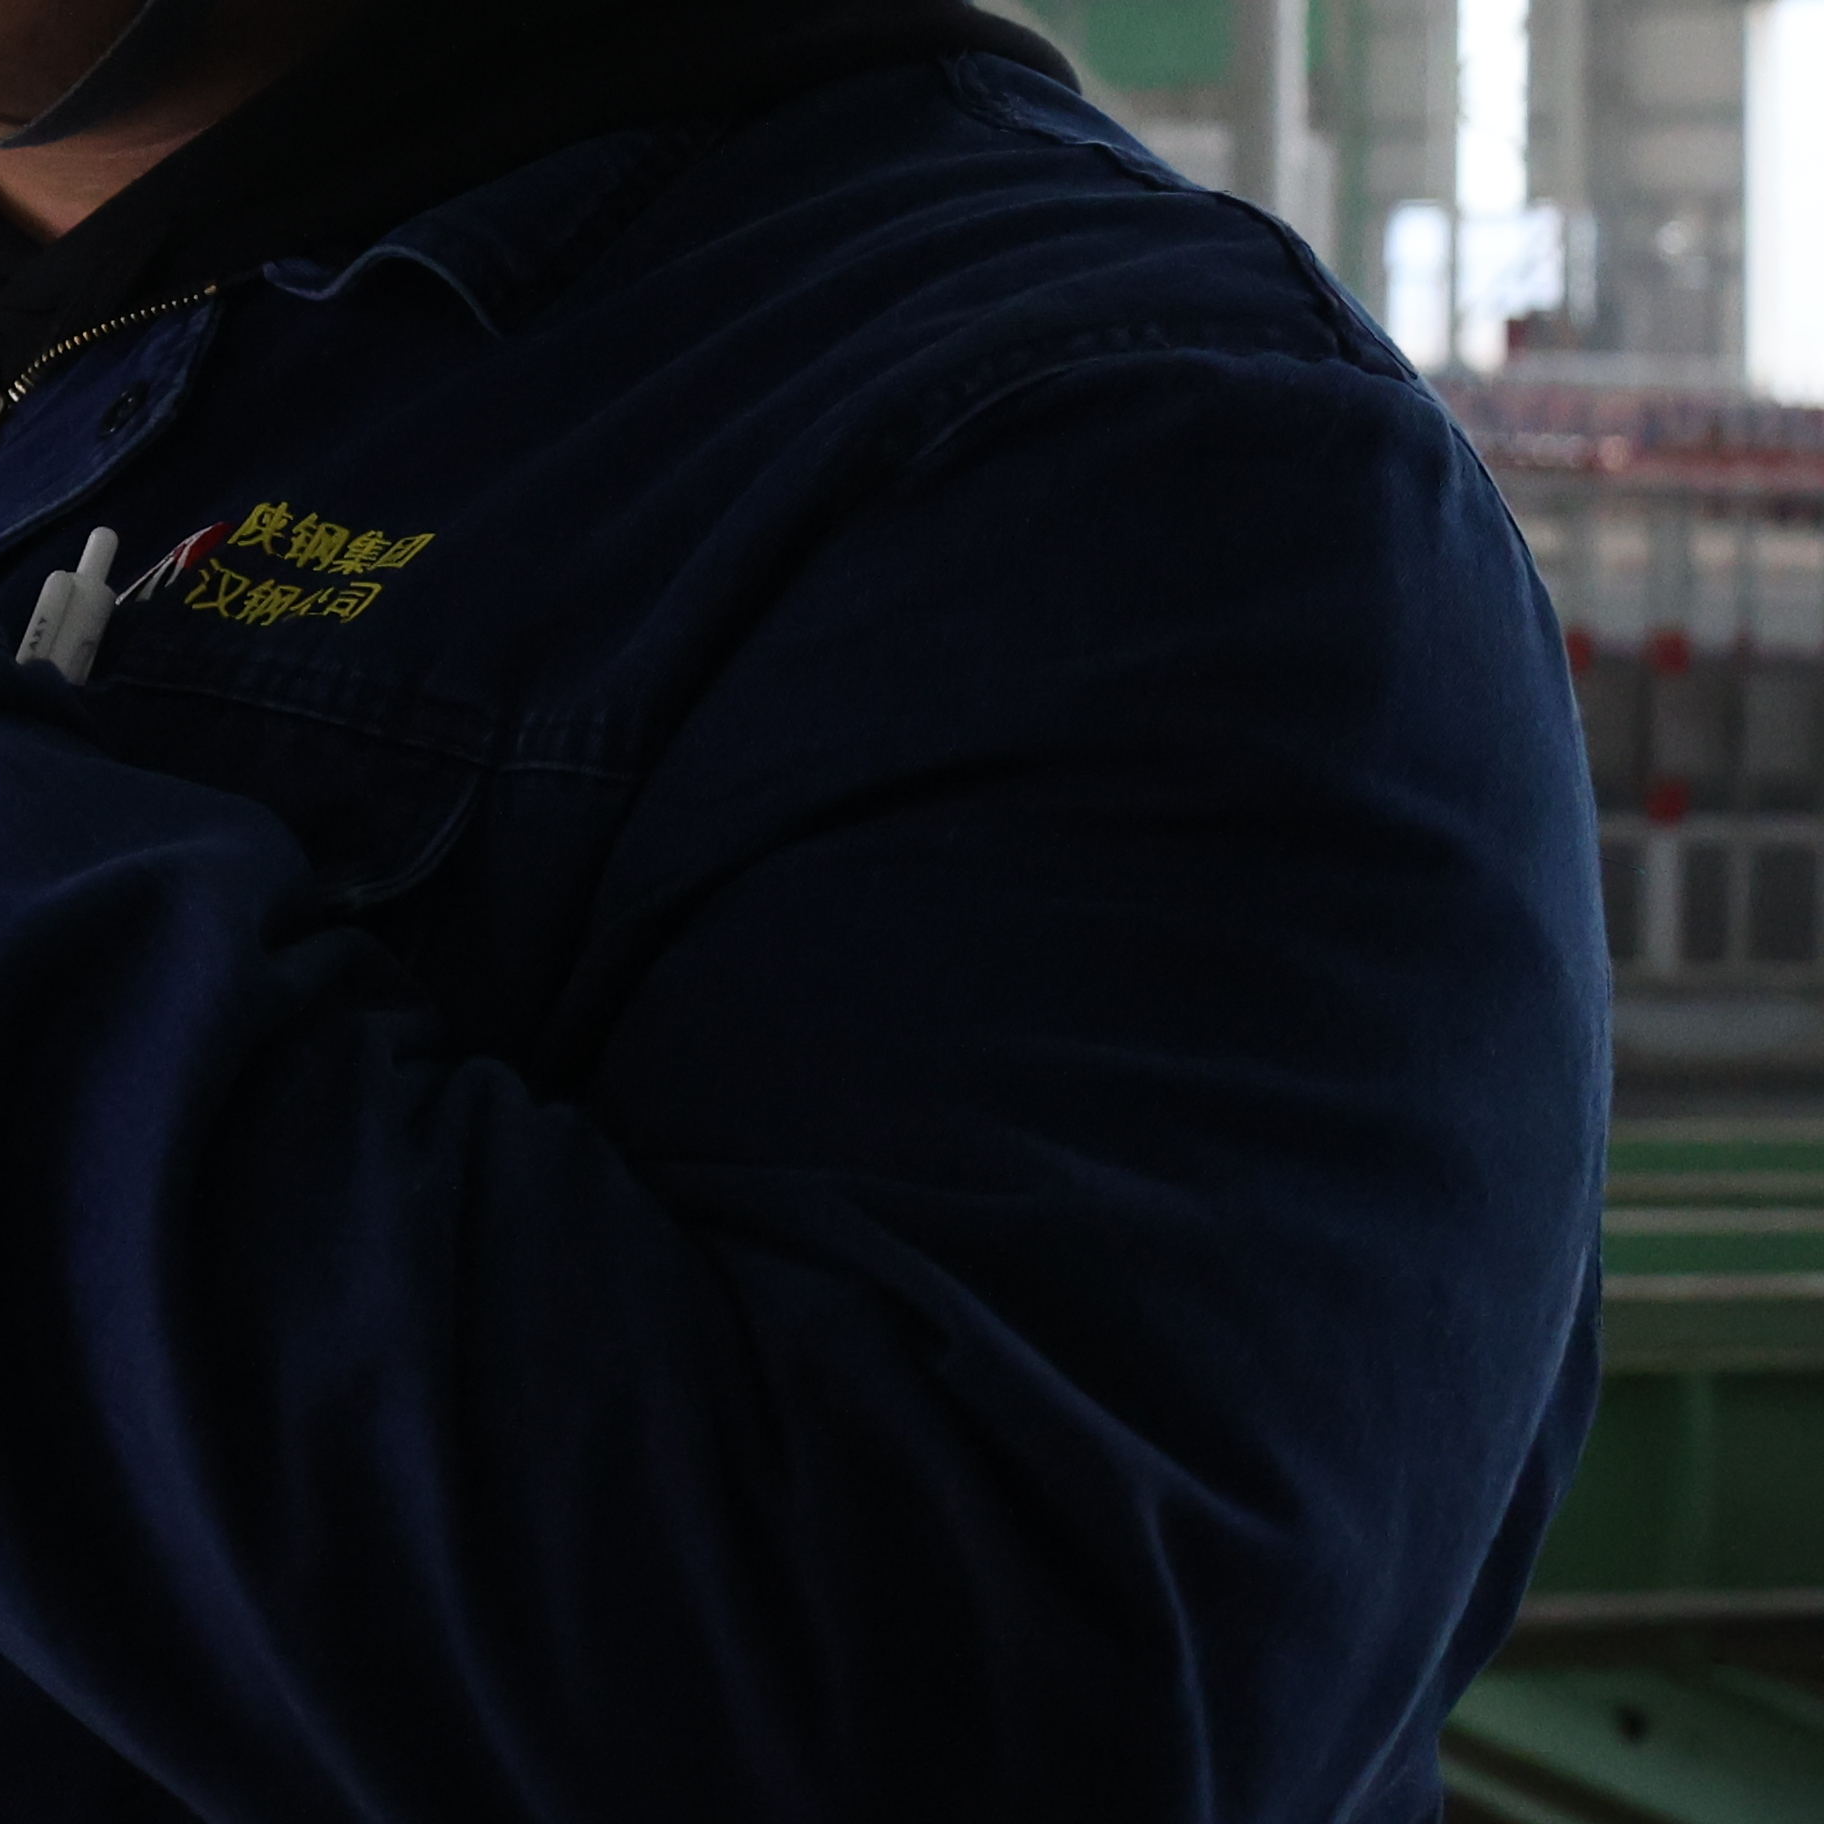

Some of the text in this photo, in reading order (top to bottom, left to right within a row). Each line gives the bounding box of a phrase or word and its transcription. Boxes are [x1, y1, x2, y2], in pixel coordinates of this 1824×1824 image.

[228, 502, 435, 575] 陕钢集团
[184, 558, 382, 626] 汉钢公司
